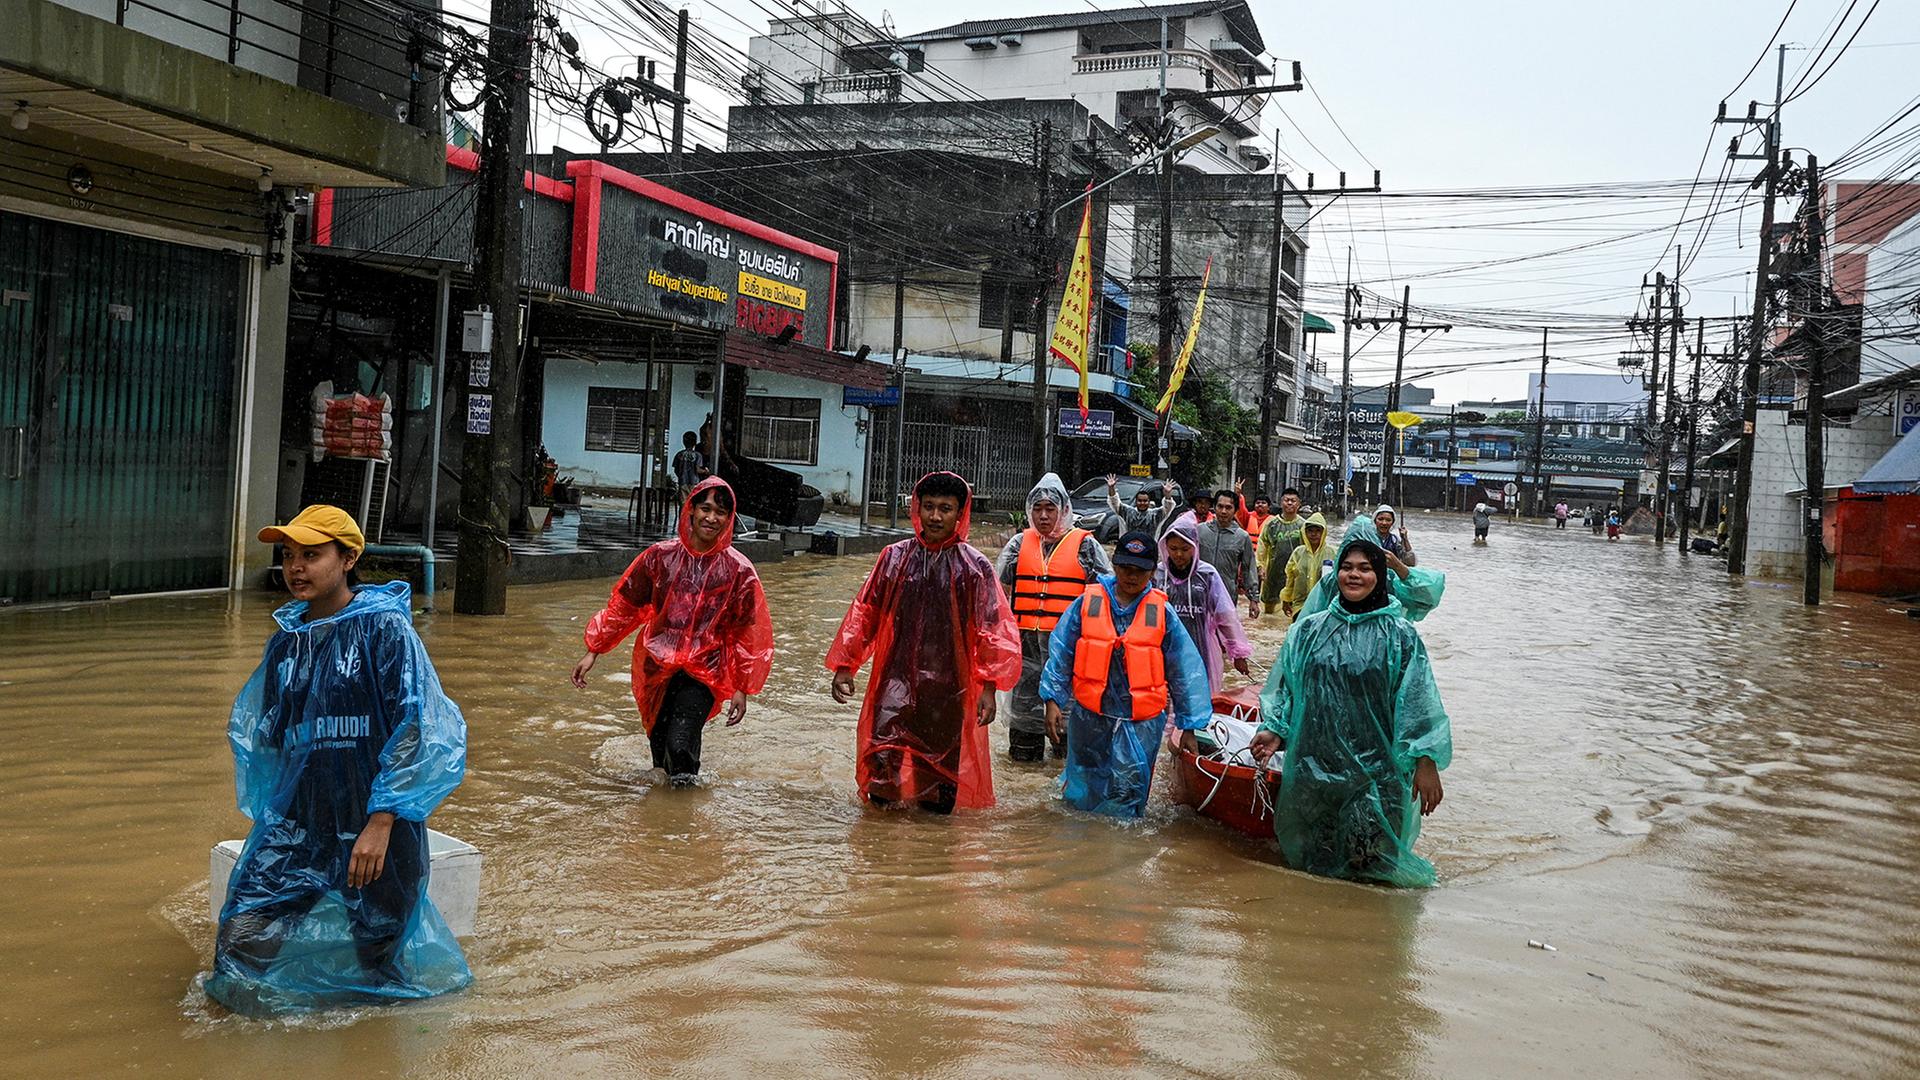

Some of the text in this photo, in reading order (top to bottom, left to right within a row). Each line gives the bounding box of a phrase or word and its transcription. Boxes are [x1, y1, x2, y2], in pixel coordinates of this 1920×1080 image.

[664, 220, 730, 259] หาดใหญ่
[647, 269, 728, 304] Hatyai SuperBike
